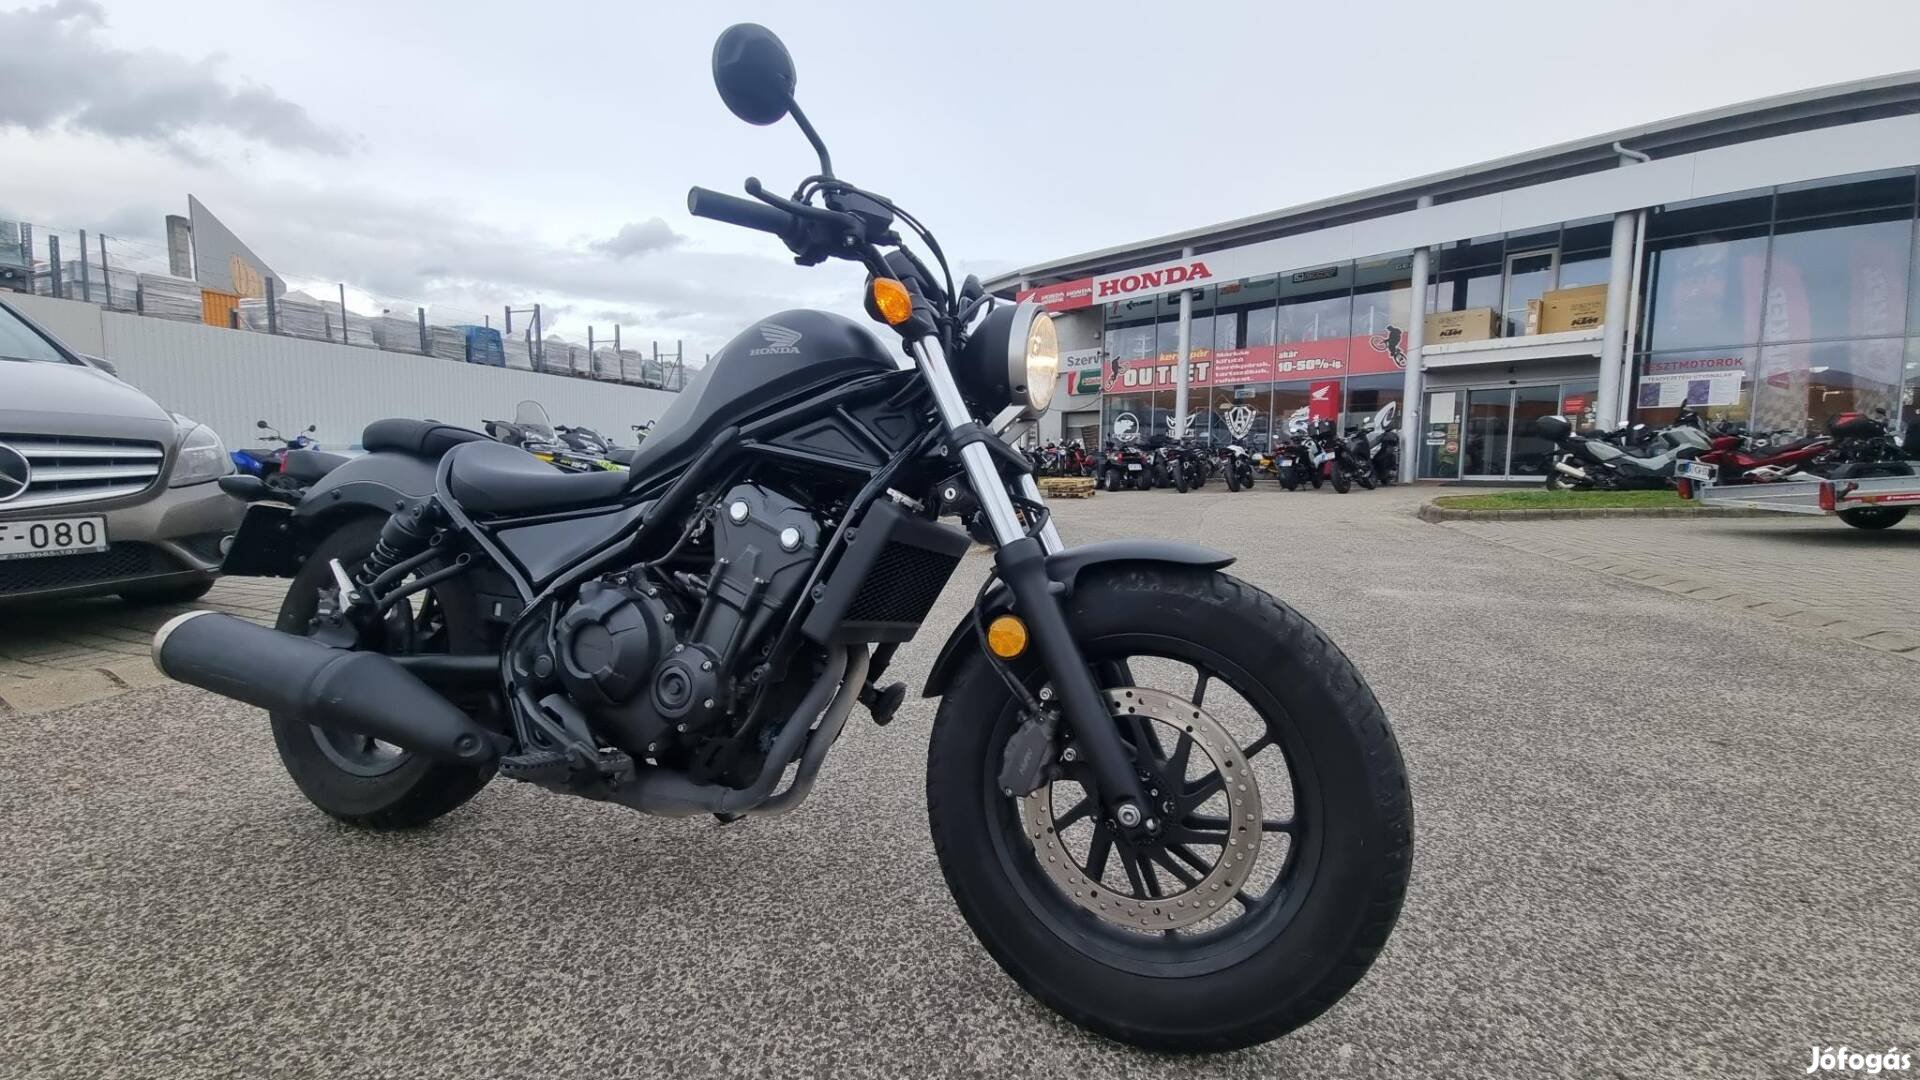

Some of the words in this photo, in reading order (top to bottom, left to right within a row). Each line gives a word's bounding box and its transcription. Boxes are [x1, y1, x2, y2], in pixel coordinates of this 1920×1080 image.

[1098, 262, 1212, 298] HONDA
[1571, 316, 1599, 326] KTM
[750, 346, 801, 357] HONDA
[1159, 348, 1210, 362] kerpár
[1643, 357, 1744, 372] ESZTMOTOROK
